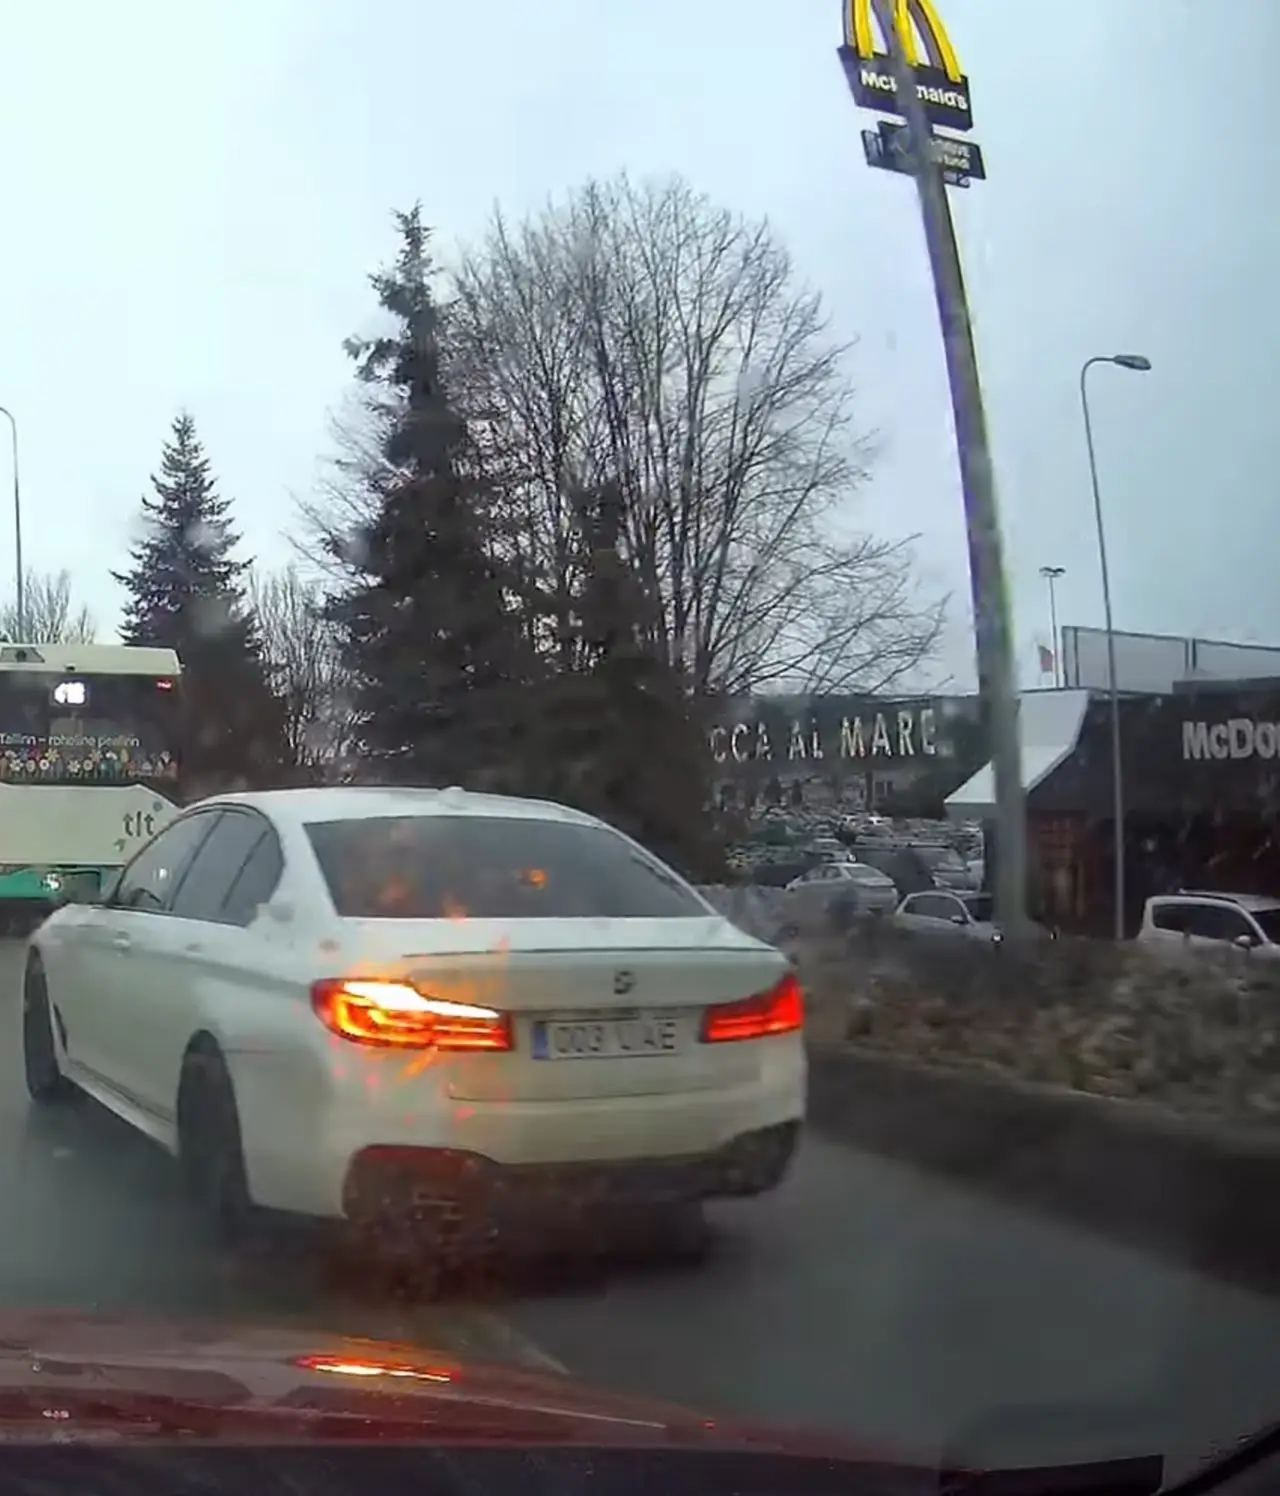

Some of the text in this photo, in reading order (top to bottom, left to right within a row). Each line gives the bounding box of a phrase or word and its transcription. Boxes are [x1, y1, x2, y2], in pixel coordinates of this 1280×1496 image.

[860, 68, 968, 110] Mcnald's
[840, 708, 937, 759] MARE
[1182, 717, 1280, 760] McDo
[122, 810, 156, 838] tlt
